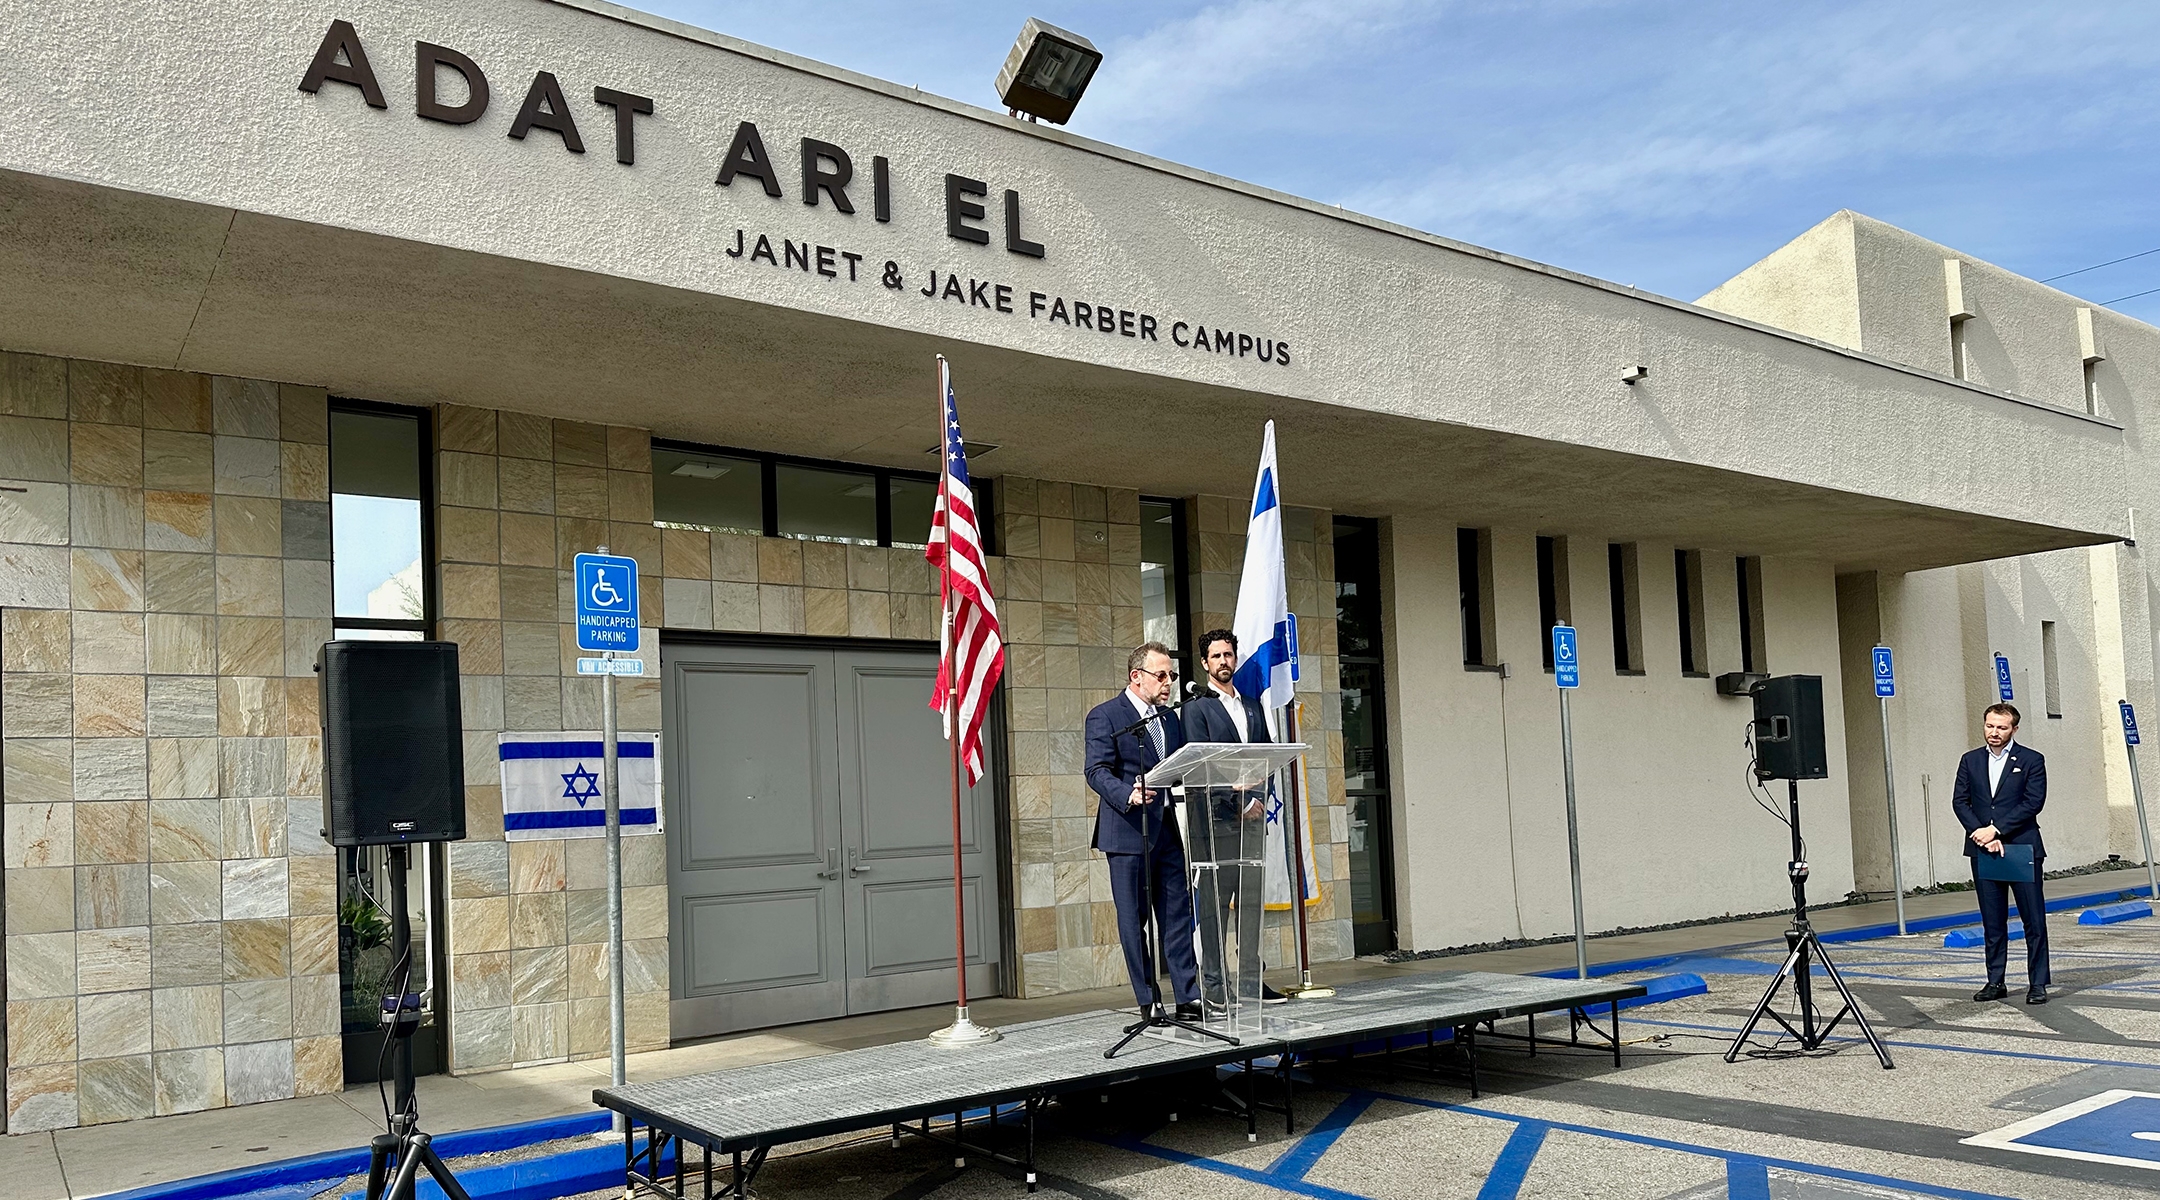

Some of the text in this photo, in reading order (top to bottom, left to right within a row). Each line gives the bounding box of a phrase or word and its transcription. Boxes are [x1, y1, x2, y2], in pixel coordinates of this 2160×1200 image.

[299, 19, 1045, 259] ADAT ARI EL
[726, 229, 1290, 366] JANET & JAKE FARBER CAMPUS
[580, 615, 636, 628] HANDICAPPED
[592, 631, 626, 642] PARKING
[597, 661, 639, 673] ACESSIBLE
